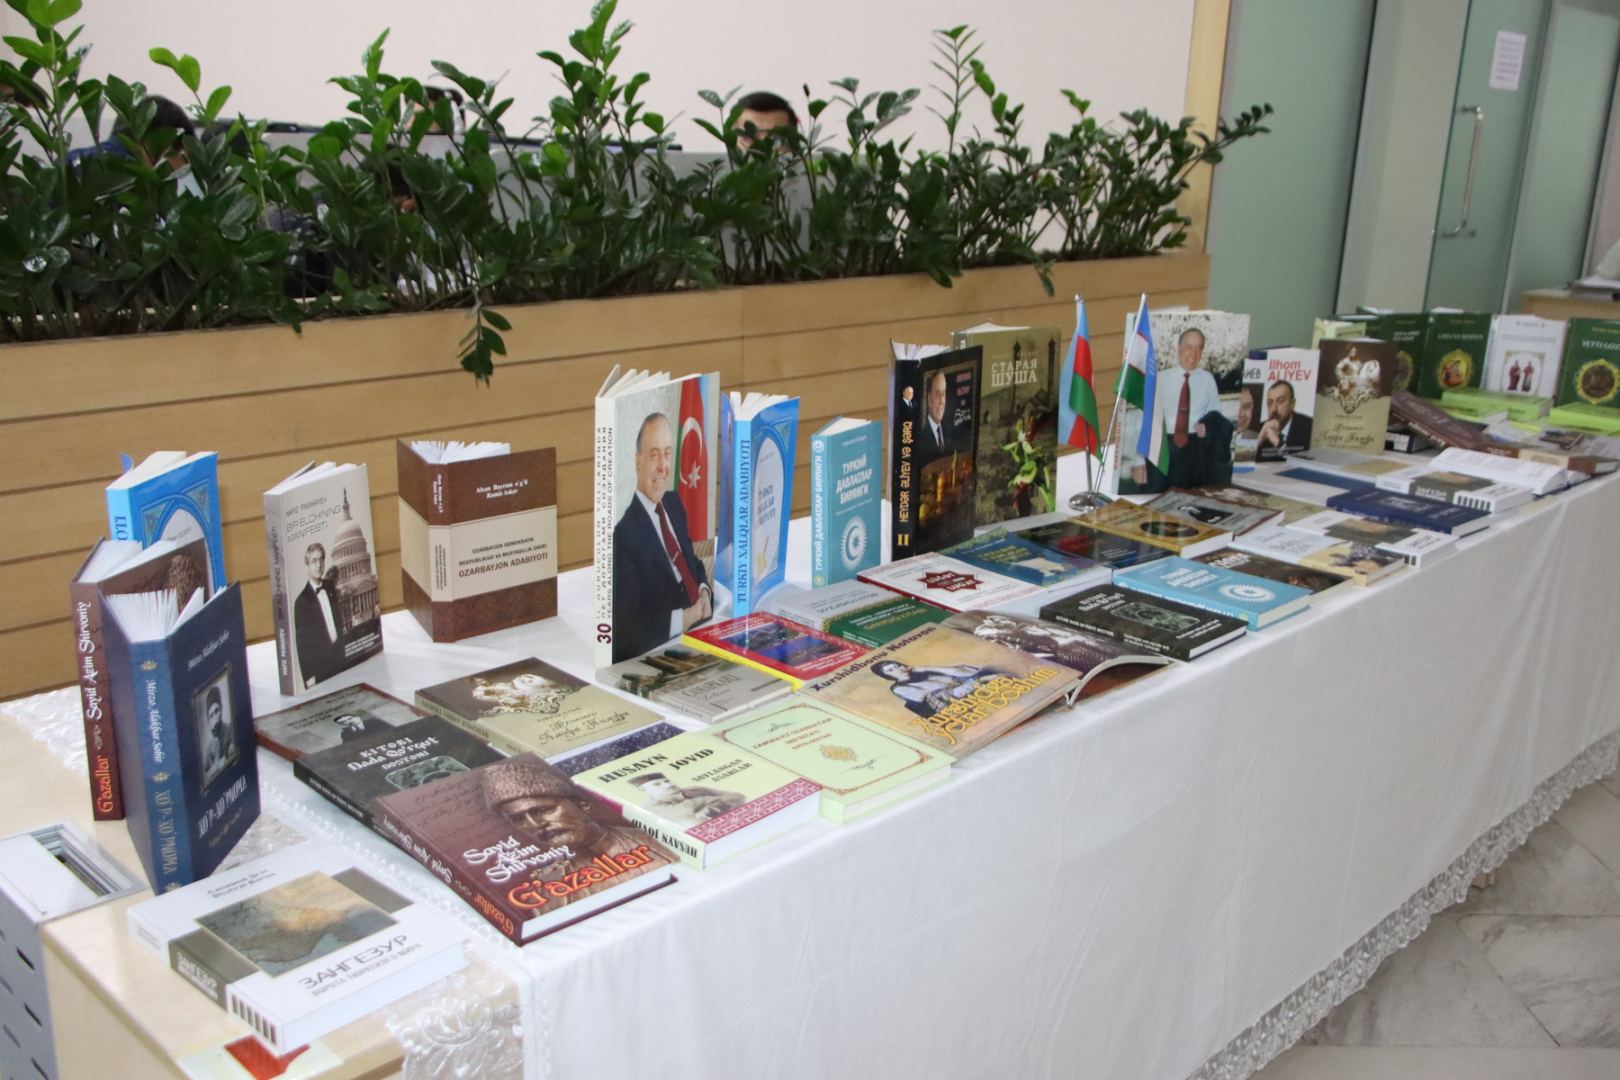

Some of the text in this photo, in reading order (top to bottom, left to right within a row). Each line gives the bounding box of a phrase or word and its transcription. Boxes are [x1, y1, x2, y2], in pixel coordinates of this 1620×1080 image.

[991, 359, 1038, 374] СТАРАЯ
[1269, 359, 1301, 370] Ilhom
[991, 369, 1037, 388] ШУША
[842, 453, 867, 475] ТУРКИЙ
[607, 480, 613, 493] OF
[836, 468, 873, 495] ДАВЛАТЛАР
[737, 439, 750, 604] TURKIY XALQLAR ADABIYOTI
[896, 533, 910, 546] II
[458, 552, 548, 578] OZARBAYJON ADABIYOTI
[596, 623, 612, 645] 30
[76, 601, 102, 720] Sayid Azim Shirvoniy
[810, 648, 888, 692] Xurshidbonu
[889, 625, 937, 653] Notavon
[360, 737, 412, 758] KITOBI
[381, 750, 431, 771] DOSTONI
[668, 748, 715, 770] JOVID
[347, 755, 387, 771] Dada
[598, 753, 669, 783] HUSAYN
[94, 754, 114, 814] G'azallar
[463, 835, 521, 865] Sayid
[495, 842, 539, 868] Azim
[661, 833, 698, 858] HUSAYN
[432, 858, 453, 884] Sayid
[486, 845, 576, 883] Shirvoniy
[507, 845, 655, 910] G'azallar
[473, 893, 514, 935] G'azallar
[298, 934, 407, 990] ЗАНГЕЗУР
